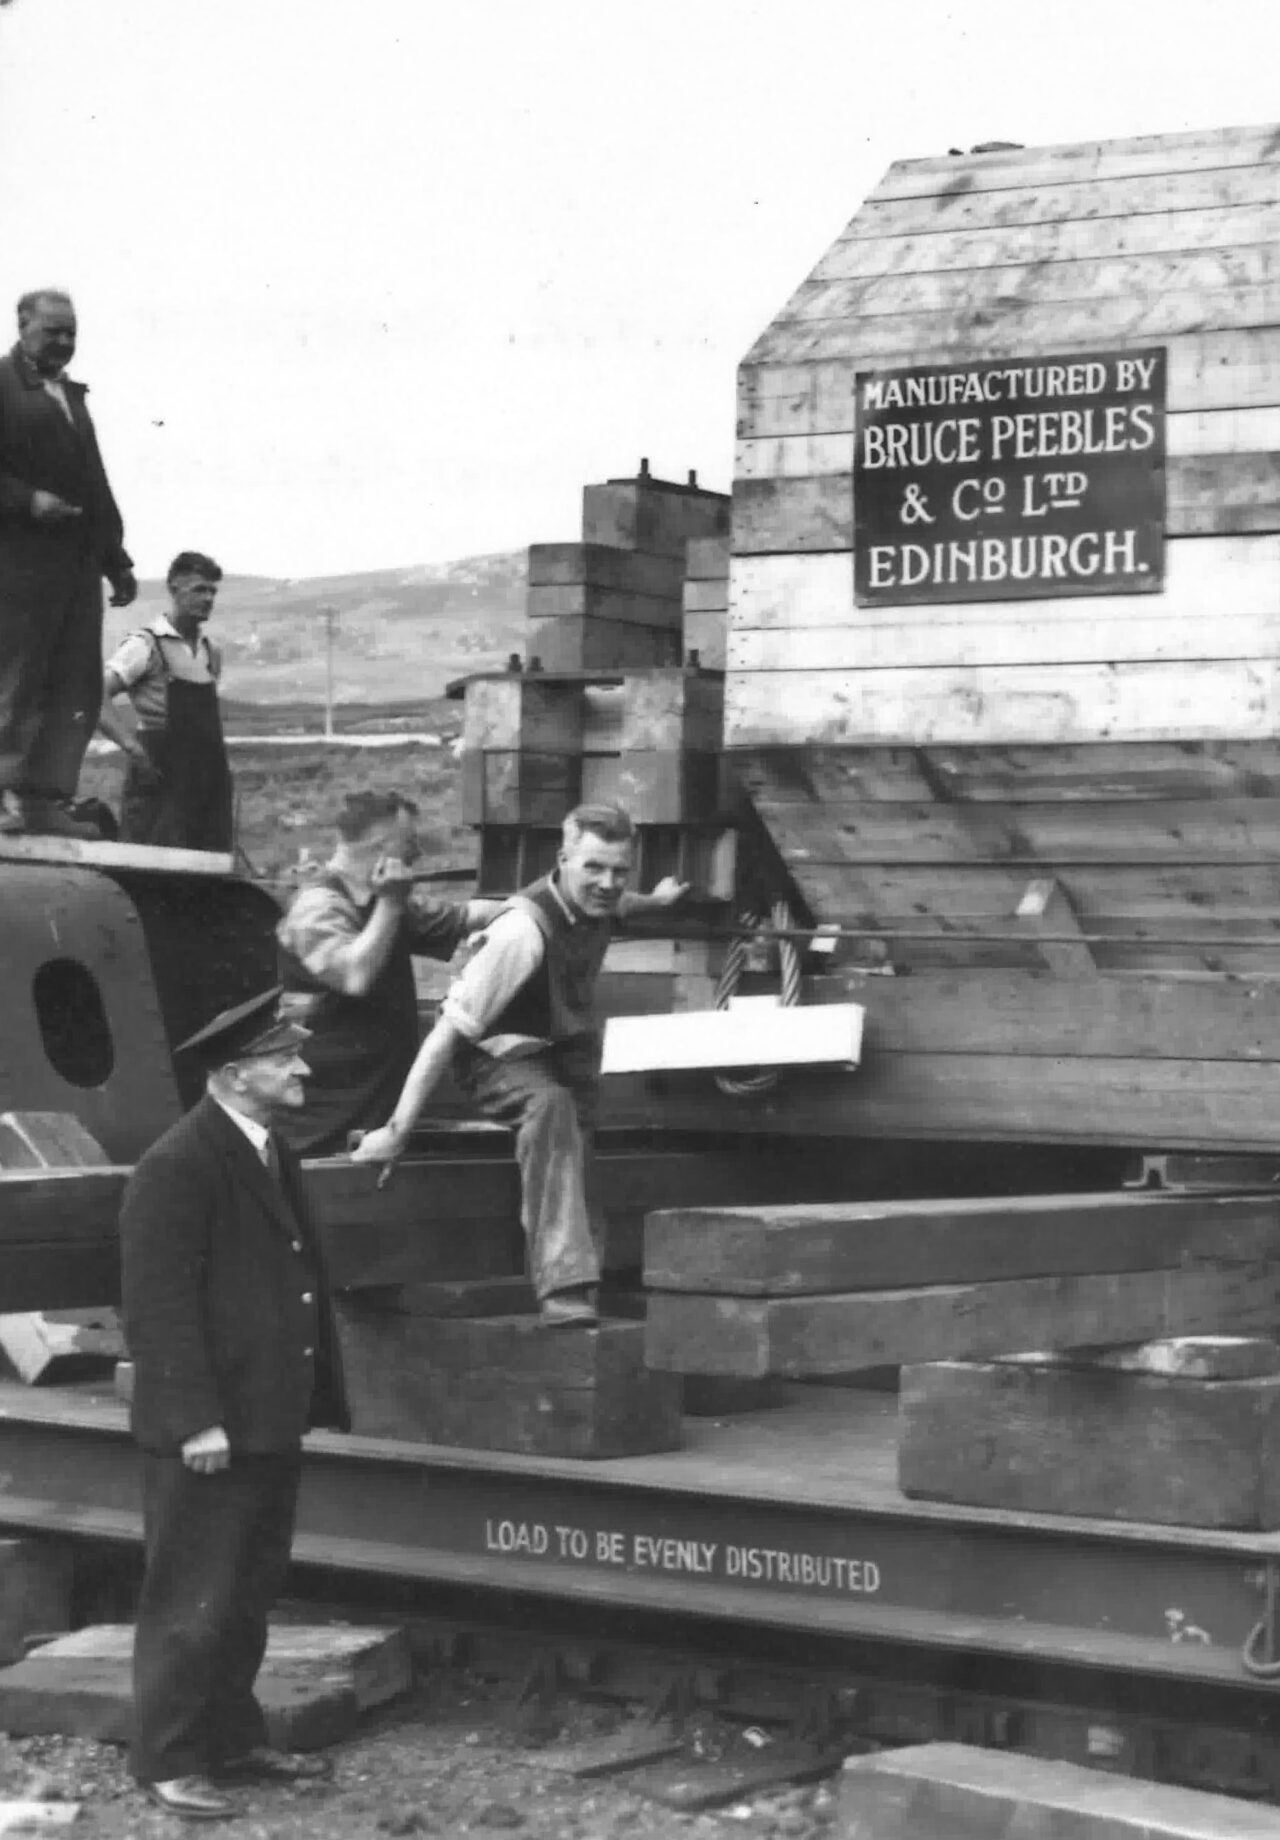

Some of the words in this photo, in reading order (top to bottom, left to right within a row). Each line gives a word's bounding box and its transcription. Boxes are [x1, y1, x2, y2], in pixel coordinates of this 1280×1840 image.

[862, 362, 1106, 410] MANUFACTURED
[1116, 357, 1156, 392] BY
[862, 417, 982, 470] BRUCE
[990, 404, 1156, 460] PEEBLES
[900, 483, 936, 525] &
[868, 529, 1151, 588] EDINBURGH.
[485, 1519, 549, 1555] LOAD
[555, 1525, 589, 1559] TO
[596, 1531, 625, 1564] BE
[633, 1536, 718, 1573] EVENLY
[726, 1545, 881, 1593] DISTRIBUTED
